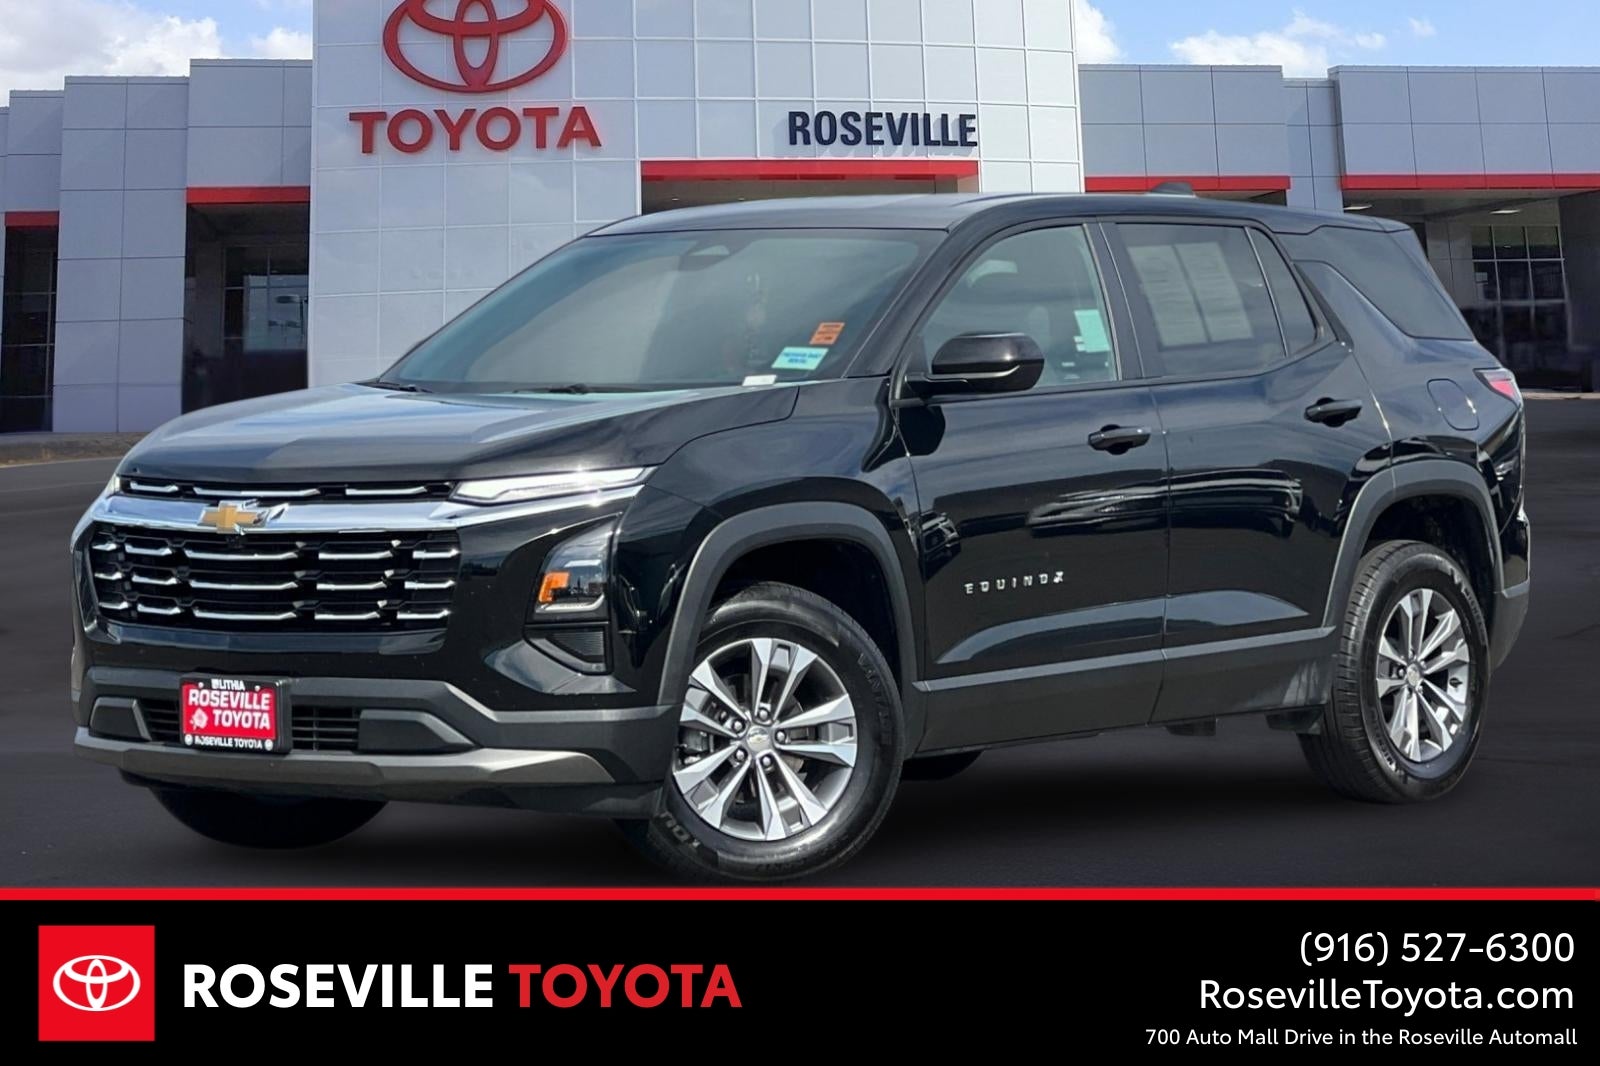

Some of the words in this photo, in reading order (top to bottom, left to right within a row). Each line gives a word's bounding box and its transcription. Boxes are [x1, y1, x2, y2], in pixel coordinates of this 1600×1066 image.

[349, 106, 602, 154] TOYOTA
[788, 110, 978, 148] ROSEVILLE
[964, 570, 1064, 595] EQUINOX
[219, 679, 246, 691] LITHIA
[188, 688, 272, 712] ROSEVILLE
[212, 708, 271, 730] TOYOTA
